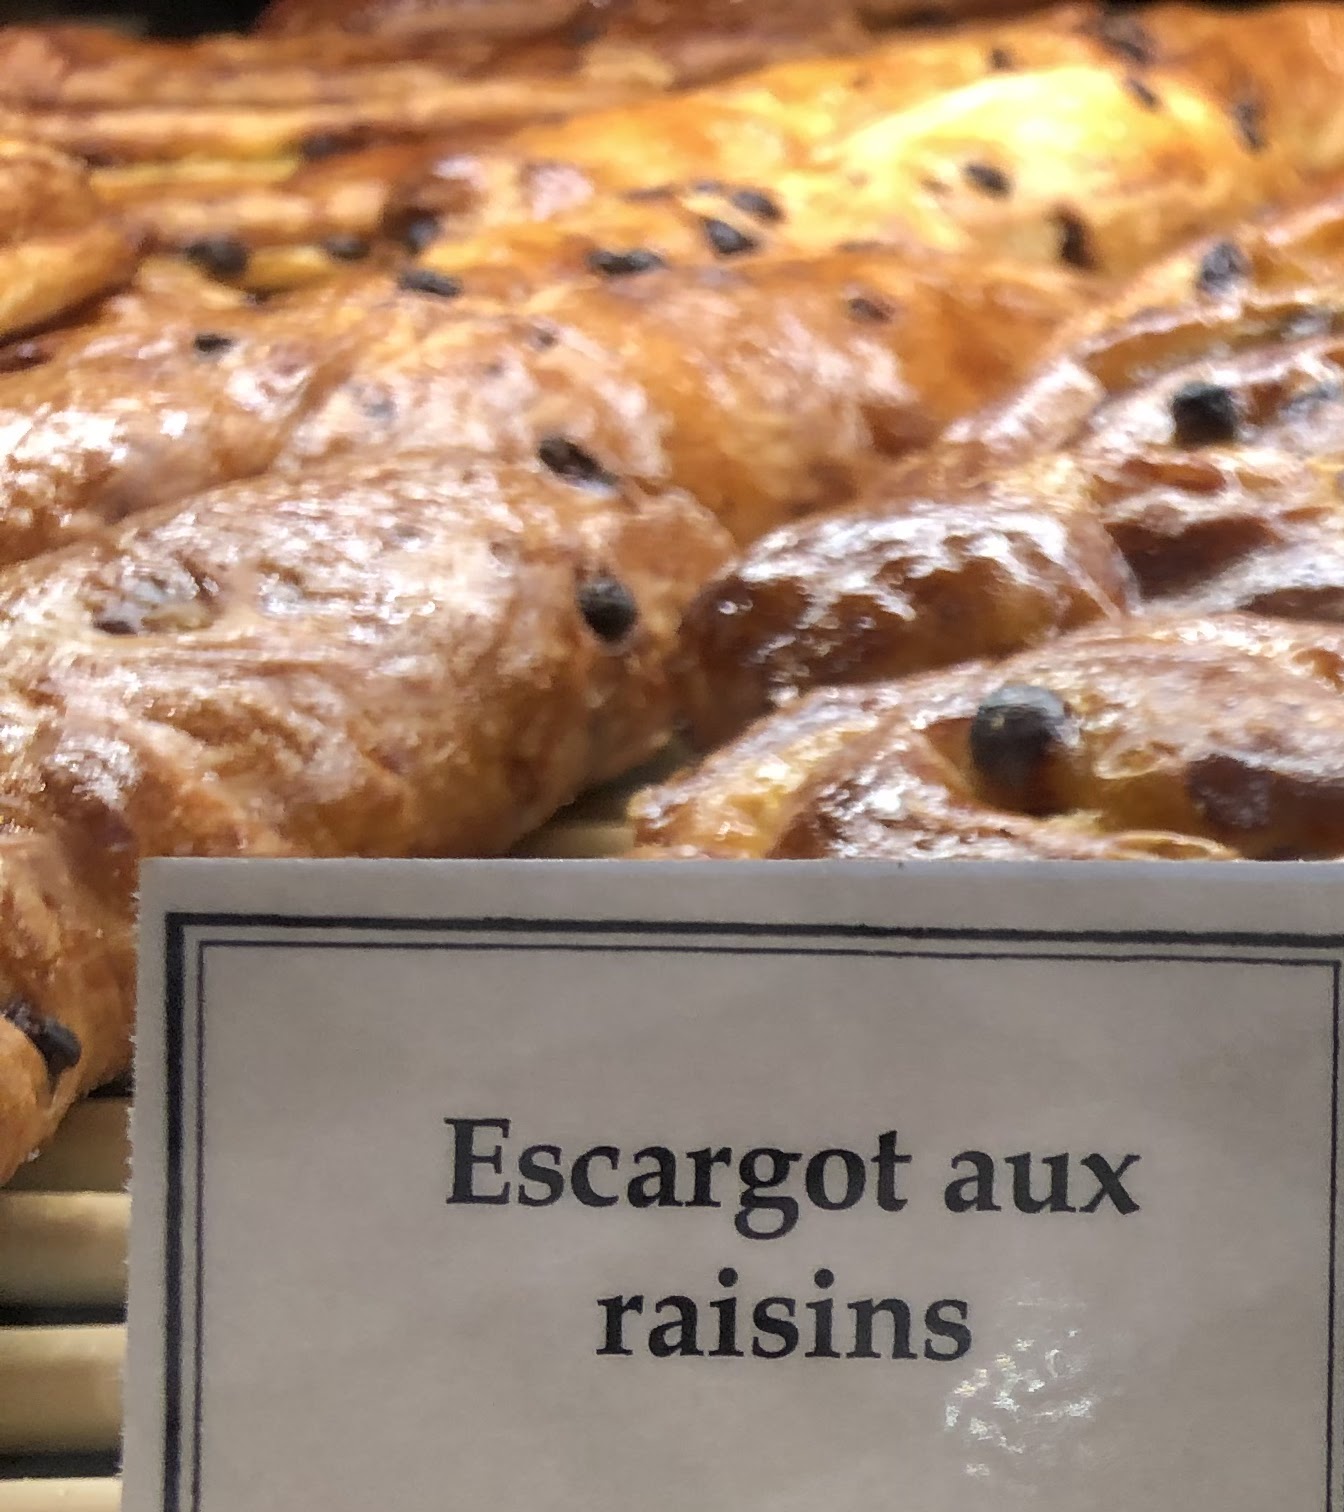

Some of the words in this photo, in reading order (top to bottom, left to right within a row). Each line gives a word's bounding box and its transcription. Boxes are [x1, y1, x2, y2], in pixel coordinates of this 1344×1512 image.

[444, 1116, 912, 1240] Escargot
[944, 1149, 1142, 1217] aux
[595, 1267, 974, 1363] raisins
